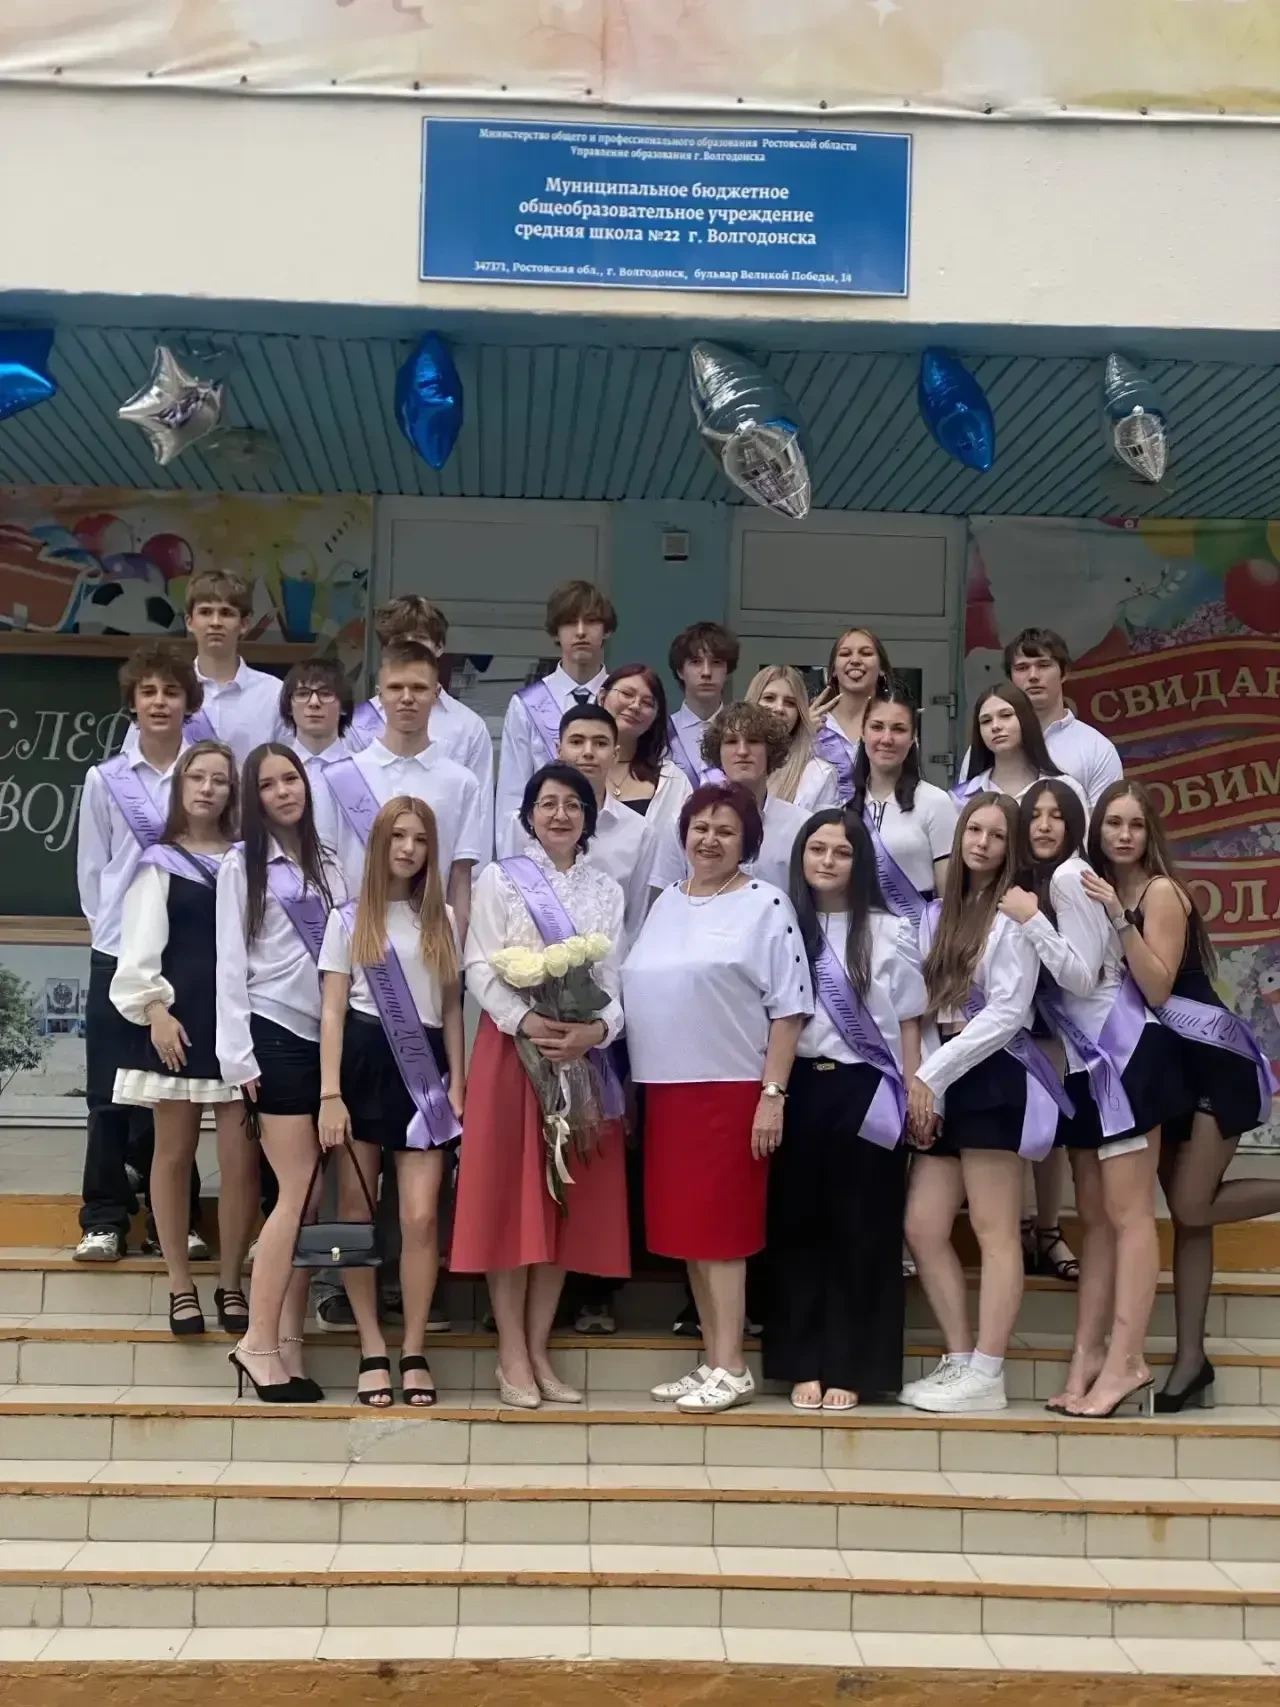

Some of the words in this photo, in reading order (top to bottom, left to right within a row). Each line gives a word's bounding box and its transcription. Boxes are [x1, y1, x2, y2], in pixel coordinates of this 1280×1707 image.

[479, 129, 550, 142] Министерство
[551, 131, 587, 141] общего
[589, 134, 597, 143] и
[599, 135, 695, 146] профессионального
[697, 138, 758, 149] образования
[762, 139, 817, 149] Ростовской
[818, 140, 857, 151] области
[570, 147, 629, 159] Управление
[631, 149, 692, 160] образования
[545, 177, 689, 197] Муниципальное
[690, 182, 790, 200] бюджетное
[519, 198, 705, 221] общеобразовательное
[707, 209, 815, 224] учреждение
[515, 224, 585, 240] средняя
[589, 228, 644, 241] школа
[648, 230, 680, 242] №22
[688, 231, 702, 244] г.
[707, 229, 817, 246] Волгодонска
[513, 262, 575, 273] Ростовская
[607, 268, 616, 276] г.
[619, 267, 688, 279] Волгодонск,
[694, 268, 739, 281] бульвар
[740, 270, 789, 280] Великой
[792, 271, 838, 284] Победы,
